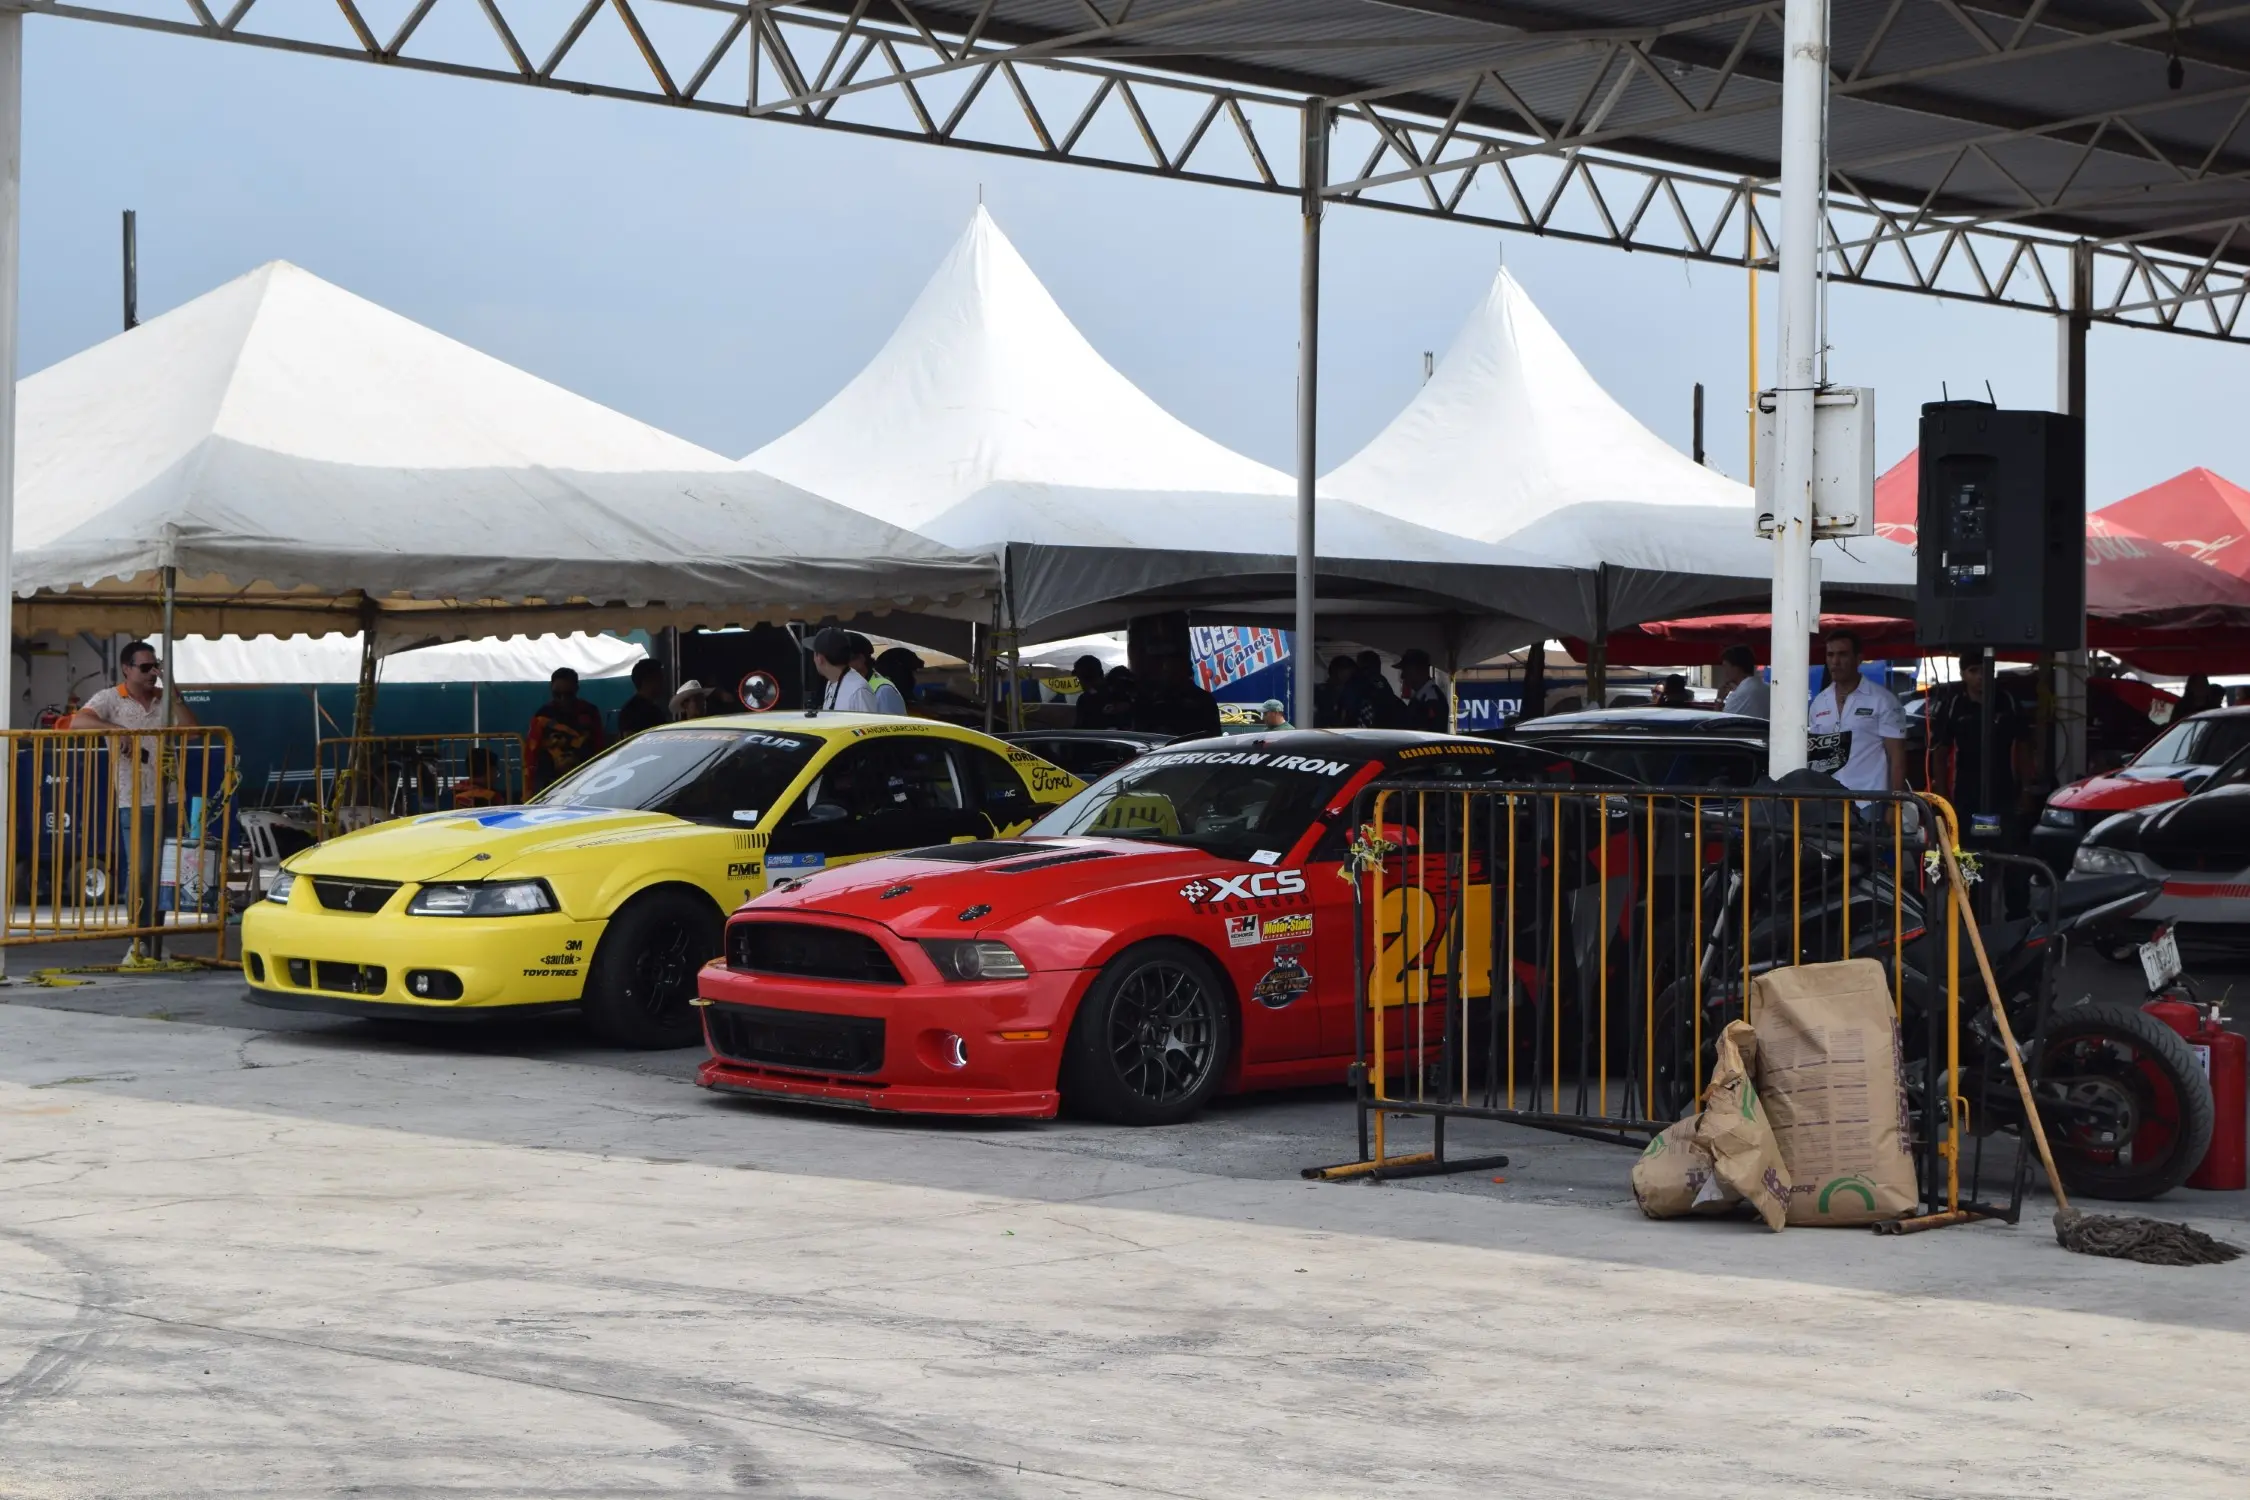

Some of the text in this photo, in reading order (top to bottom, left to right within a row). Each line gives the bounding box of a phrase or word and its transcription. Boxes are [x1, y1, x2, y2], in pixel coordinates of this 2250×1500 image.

[1223, 634, 1275, 675] Canel's
[744, 734, 801, 749] CUP
[1123, 752, 1350, 776] AMERICAN IRON
[1032, 766, 1073, 792] Ford
[728, 863, 760, 876] PMG
[1207, 869, 1306, 902] XCS
[565, 939, 583, 951] 3M
[523, 969, 579, 977] TOYO TIRES
